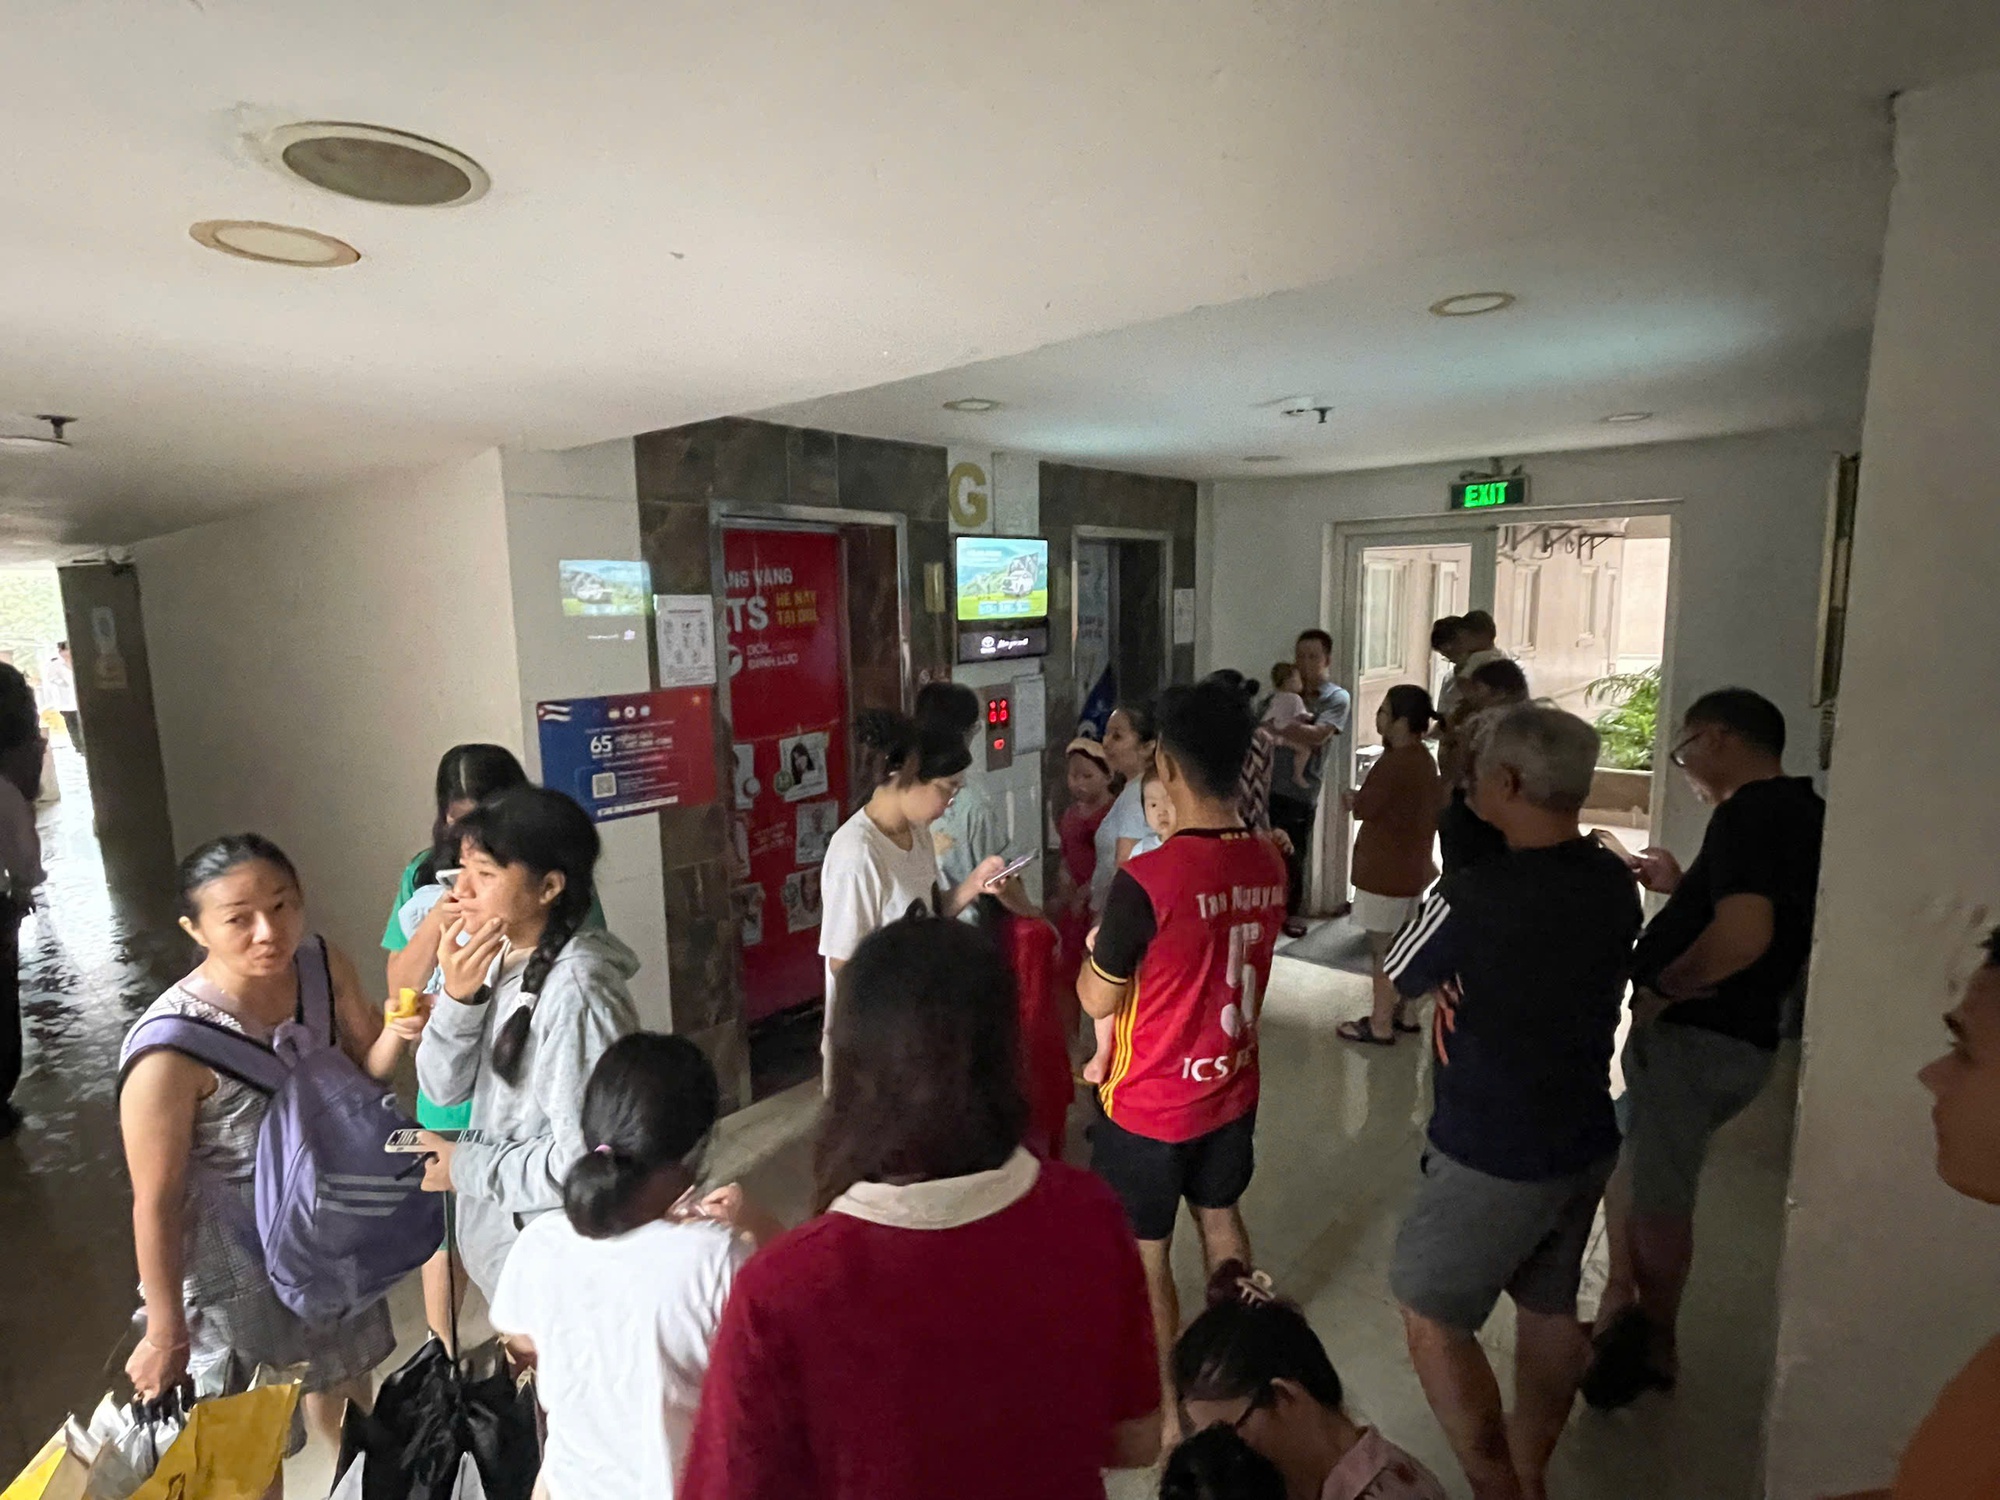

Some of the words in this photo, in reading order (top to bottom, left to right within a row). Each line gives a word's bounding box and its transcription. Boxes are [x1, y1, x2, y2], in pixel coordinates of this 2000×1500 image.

[949, 462, 988, 527] G
[1464, 481, 1508, 507] EXIT
[590, 735, 613, 753] 65
[1182, 1055, 1229, 1082] ICS
